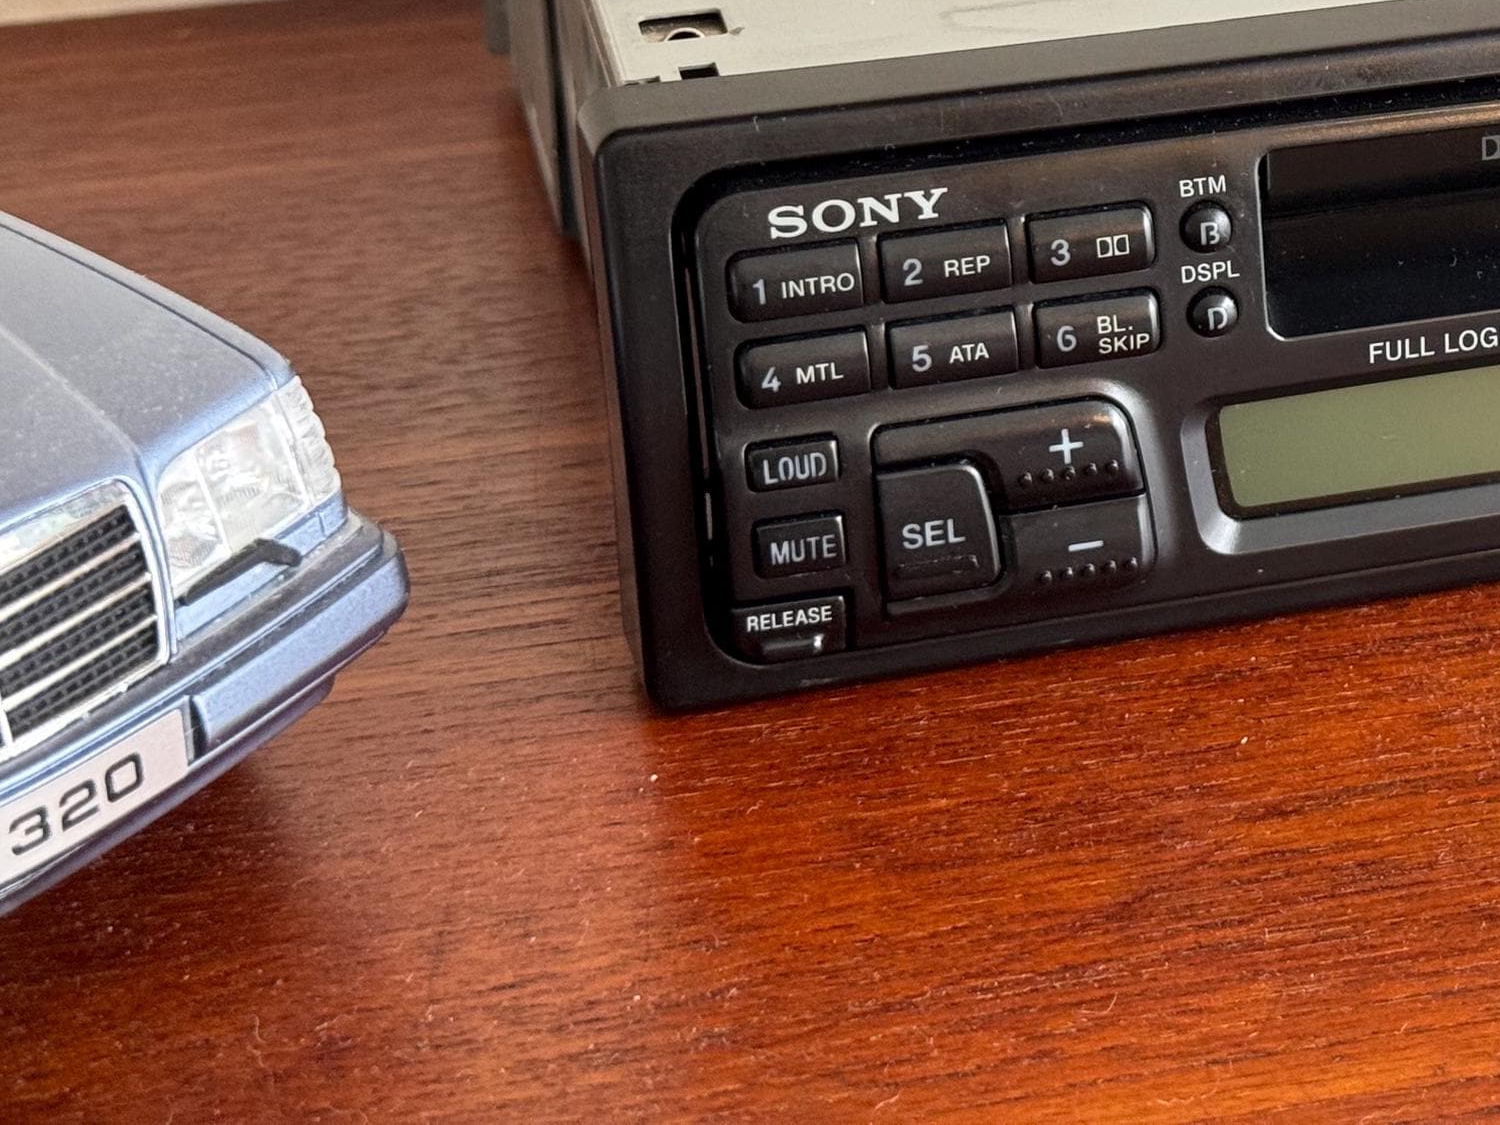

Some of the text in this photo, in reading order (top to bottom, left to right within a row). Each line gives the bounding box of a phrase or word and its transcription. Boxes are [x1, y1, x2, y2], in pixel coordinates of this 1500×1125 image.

[1179, 175, 1227, 198] BTM
[767, 187, 949, 239] SONY
[1200, 221, 1221, 246] B
[1050, 238, 1071, 267] 3
[902, 255, 991, 287] 2 REP
[1180, 260, 1240, 285] DSPL
[752, 272, 855, 306] 1 INTRO
[1207, 306, 1229, 331] D
[1056, 325, 1078, 353] 6
[1098, 332, 1151, 356] SKIP
[1368, 338, 1435, 364] FULL
[911, 342, 990, 373] 5 ATA
[761, 362, 844, 394] 4 MTL
[762, 451, 827, 486] LOUD
[902, 517, 967, 551] SEL
[769, 533, 838, 567] MUTE
[746, 604, 833, 634] RELEASE
[9, 752, 144, 856] 320
